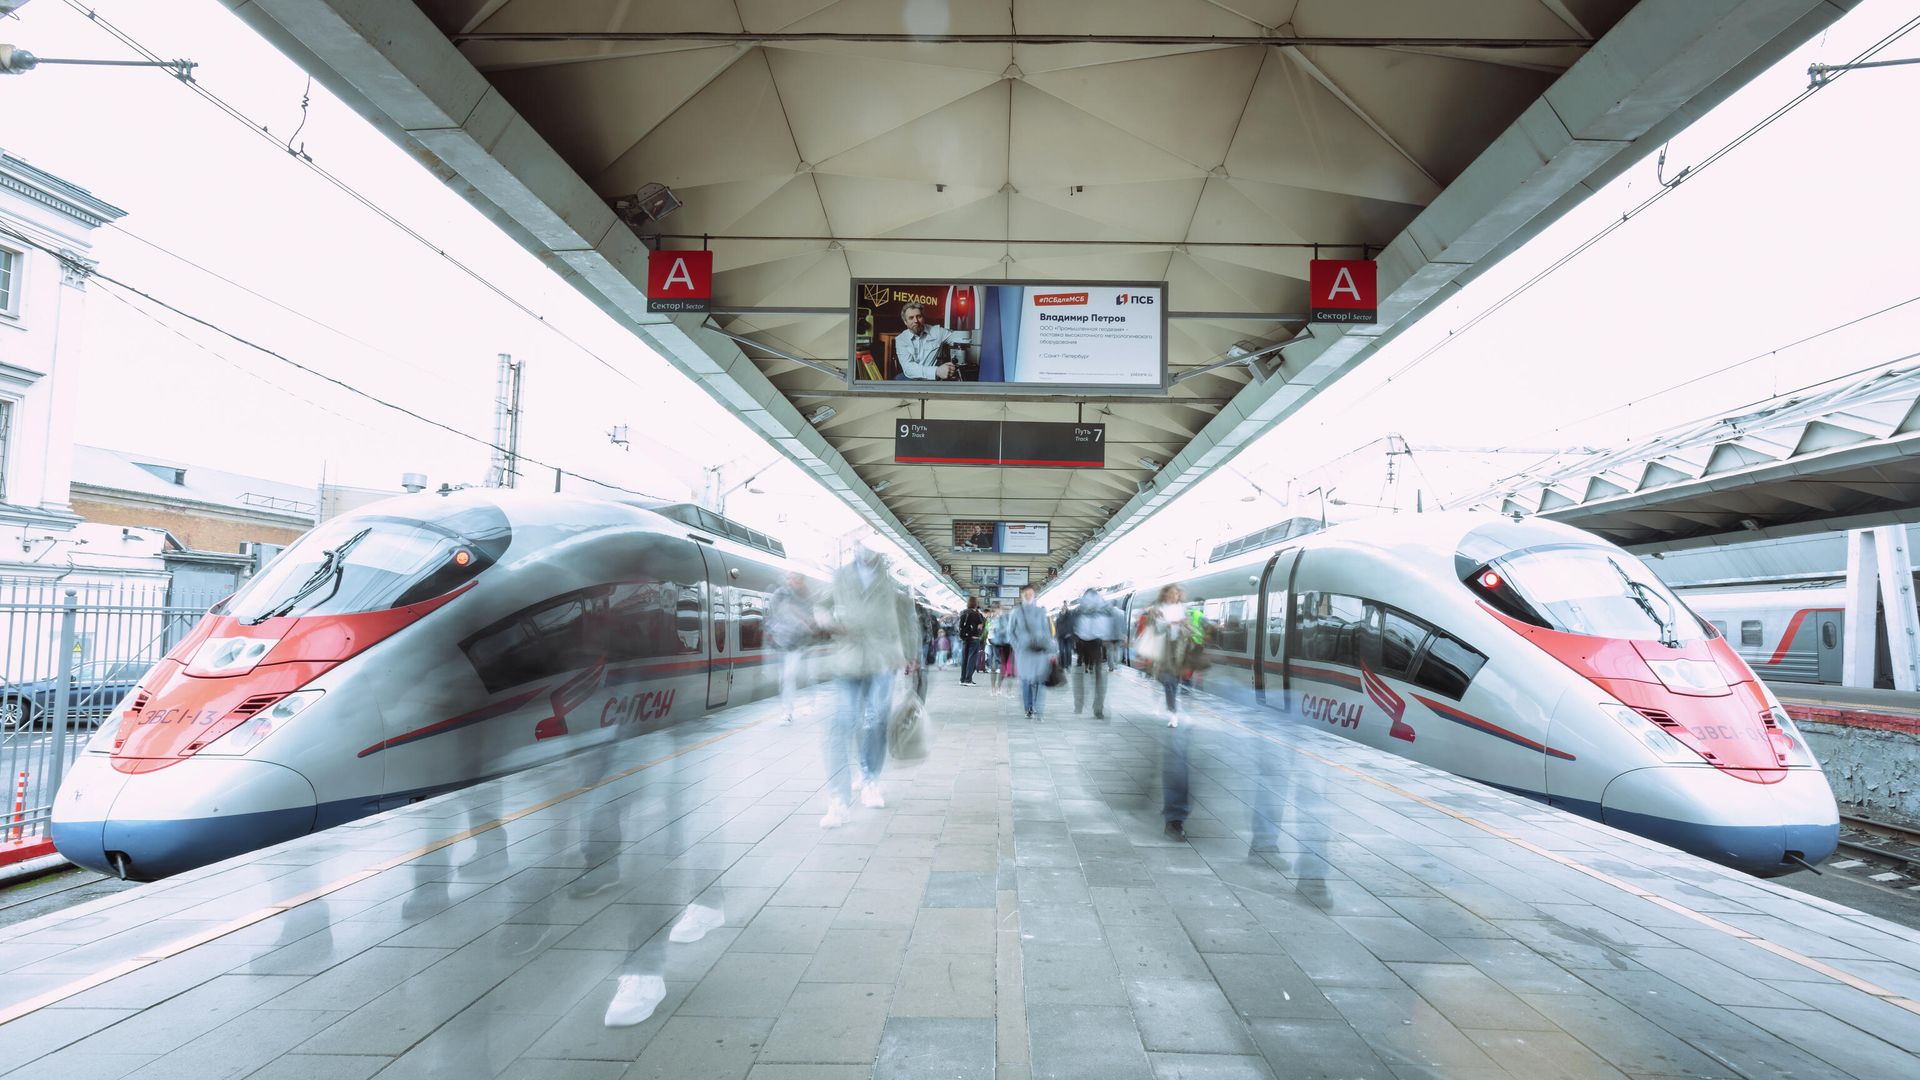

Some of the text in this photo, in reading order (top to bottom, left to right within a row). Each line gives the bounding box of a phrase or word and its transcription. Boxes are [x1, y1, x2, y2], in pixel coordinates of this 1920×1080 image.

[893, 291, 938, 306] HEXAGON
[1131, 295, 1154, 304] ПСБ
[651, 301, 681, 311] Сектор
[1040, 313, 1126, 324] Владимир Петров
[1317, 311, 1348, 321] Сектор
[900, 424, 909, 438] 9
[1075, 428, 1103, 442] Путь 7
[601, 688, 676, 728] САПСАН
[1301, 693, 1364, 730] САПСАН
